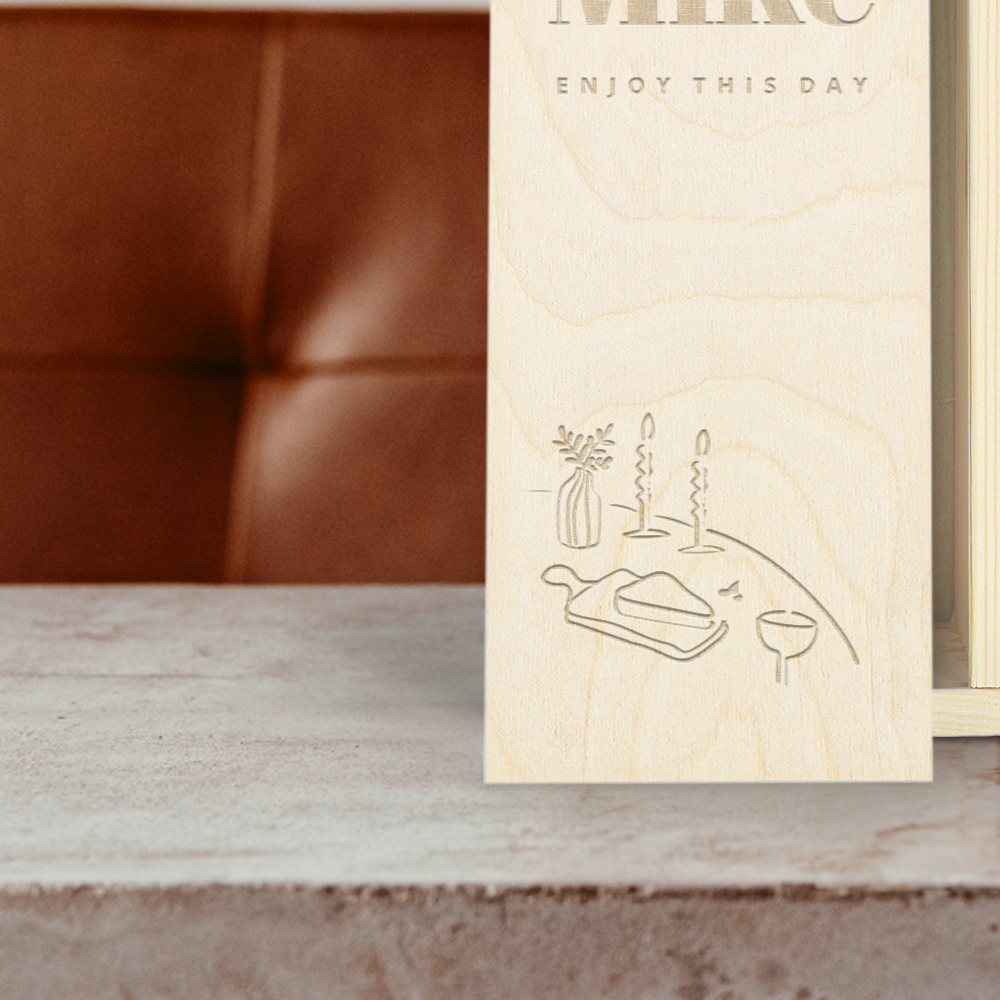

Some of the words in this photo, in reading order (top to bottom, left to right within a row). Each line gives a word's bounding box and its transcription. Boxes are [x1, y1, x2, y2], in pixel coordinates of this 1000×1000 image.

[557, 77, 671, 98] ENJOY
[692, 77, 777, 94] THIS
[800, 77, 867, 94] DAY
